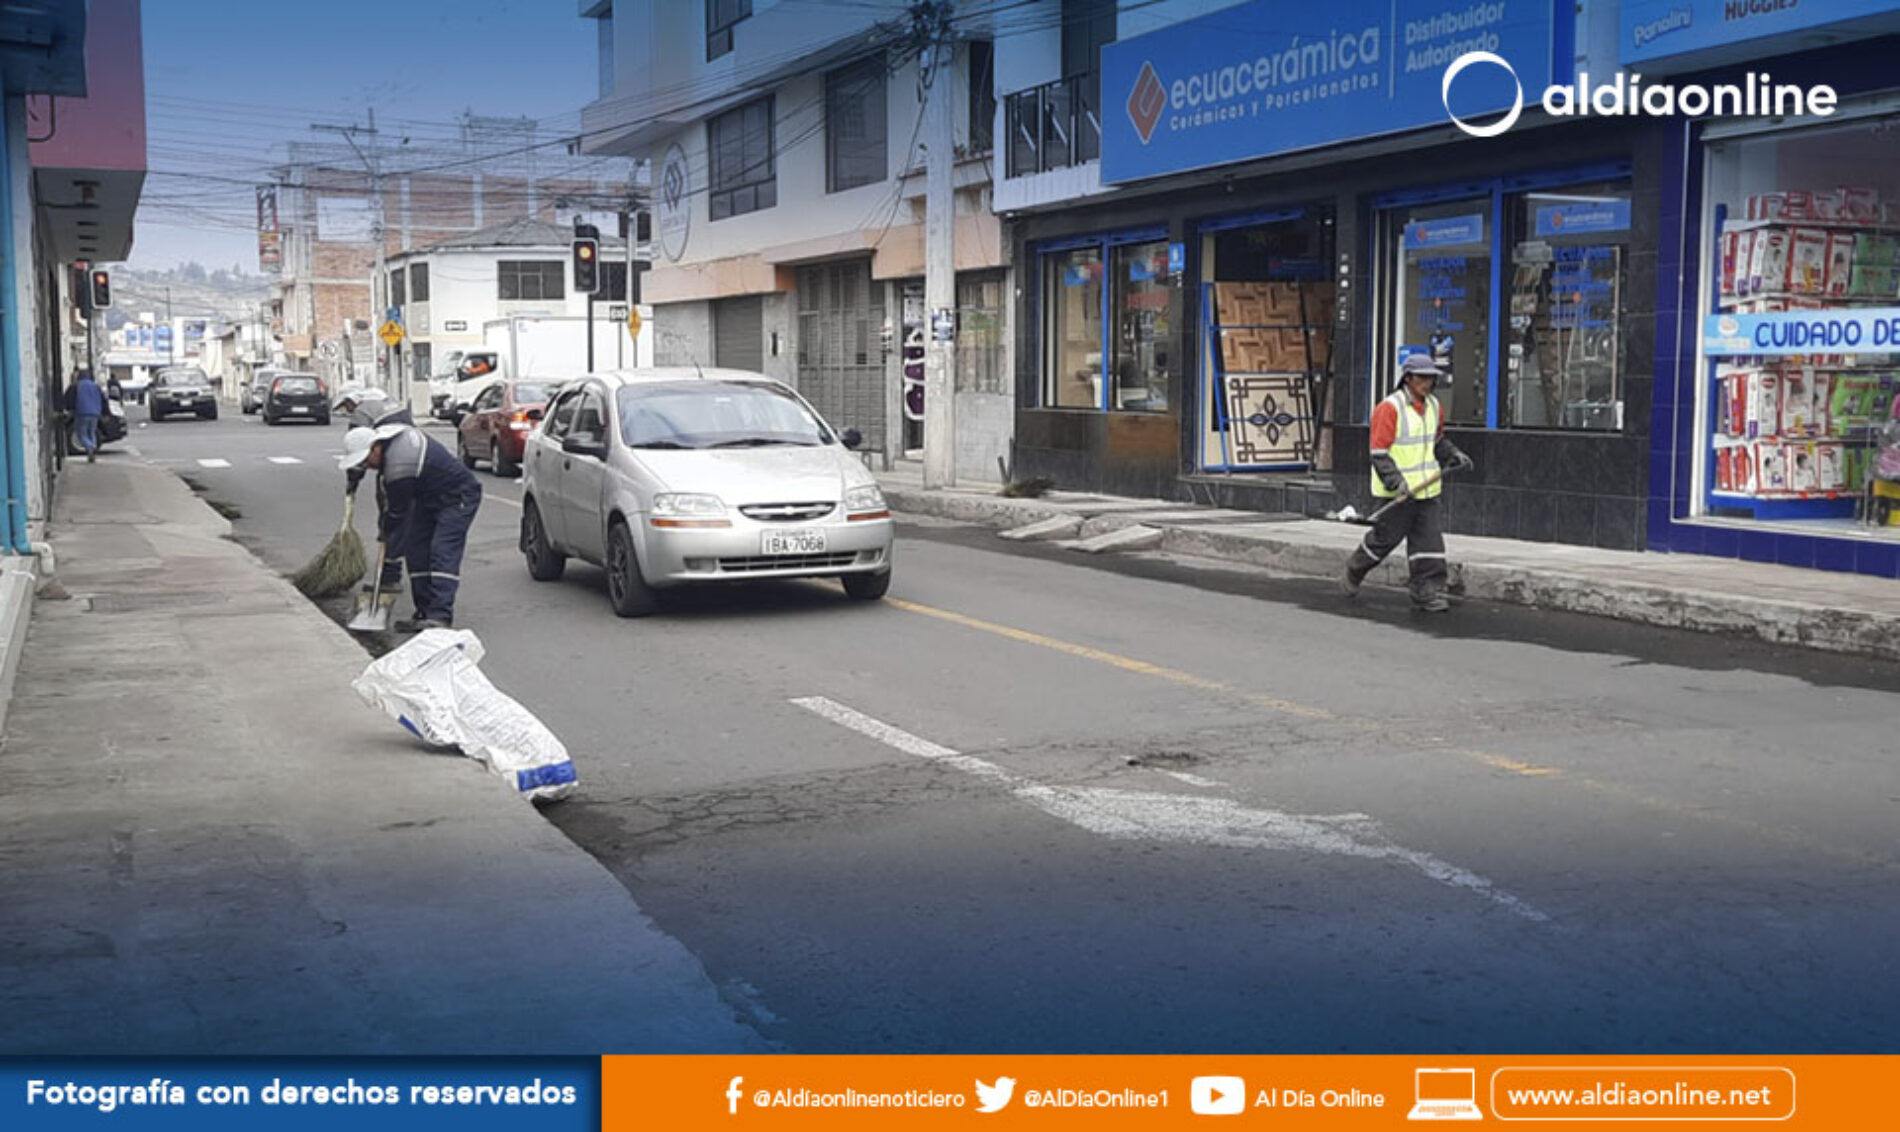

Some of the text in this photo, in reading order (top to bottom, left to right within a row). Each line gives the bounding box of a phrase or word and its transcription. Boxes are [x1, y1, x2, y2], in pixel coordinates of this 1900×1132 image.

[1405, 2, 1505, 45] Distribuidor
[1170, 27, 1380, 110] ecuacerámica
[1405, 31, 1500, 72] Autorizado
[1170, 106, 1244, 131] Cerámicas
[1266, 73, 1379, 110] Porcelanatos
[1754, 320, 1863, 348] CUIDADO
